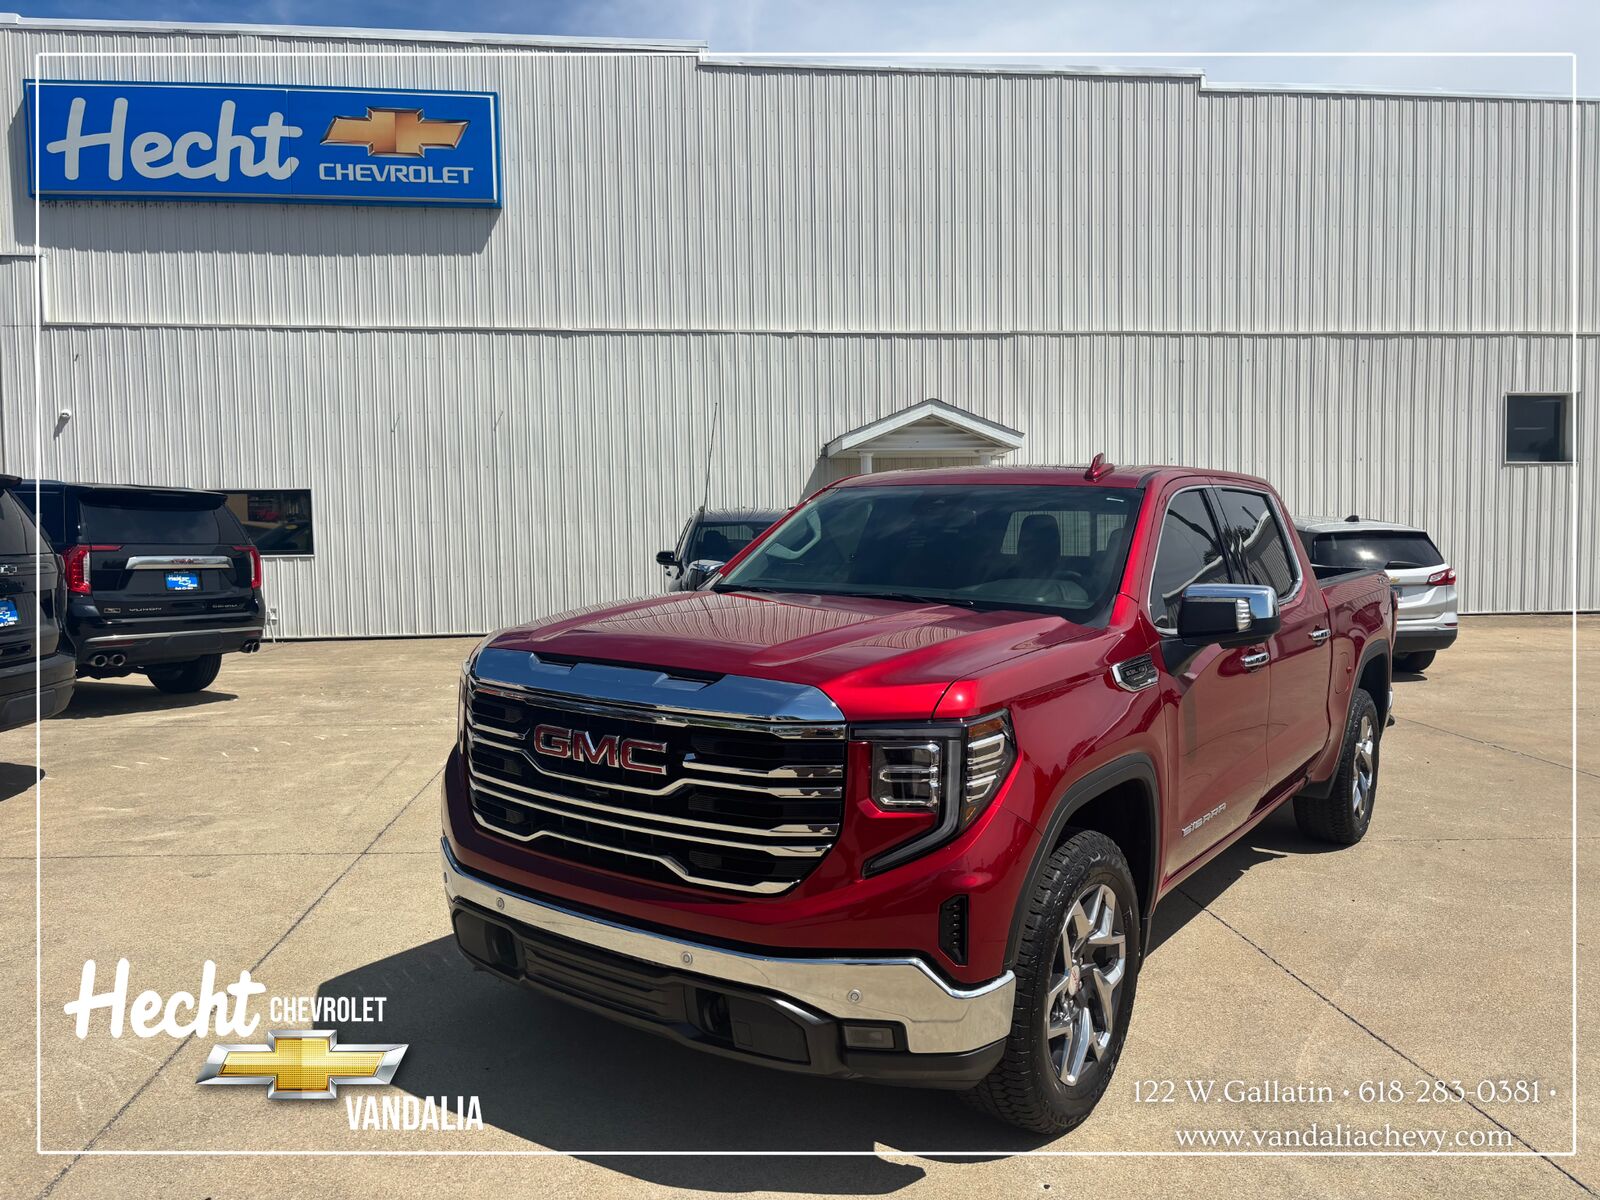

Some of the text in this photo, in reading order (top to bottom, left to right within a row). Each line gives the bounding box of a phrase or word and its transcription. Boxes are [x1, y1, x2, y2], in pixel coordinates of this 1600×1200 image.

[46, 97, 303, 182] Hecht
[319, 163, 474, 184] CHEVROLET
[534, 723, 667, 775] GMC
[1181, 802, 1227, 838] SIERRA
